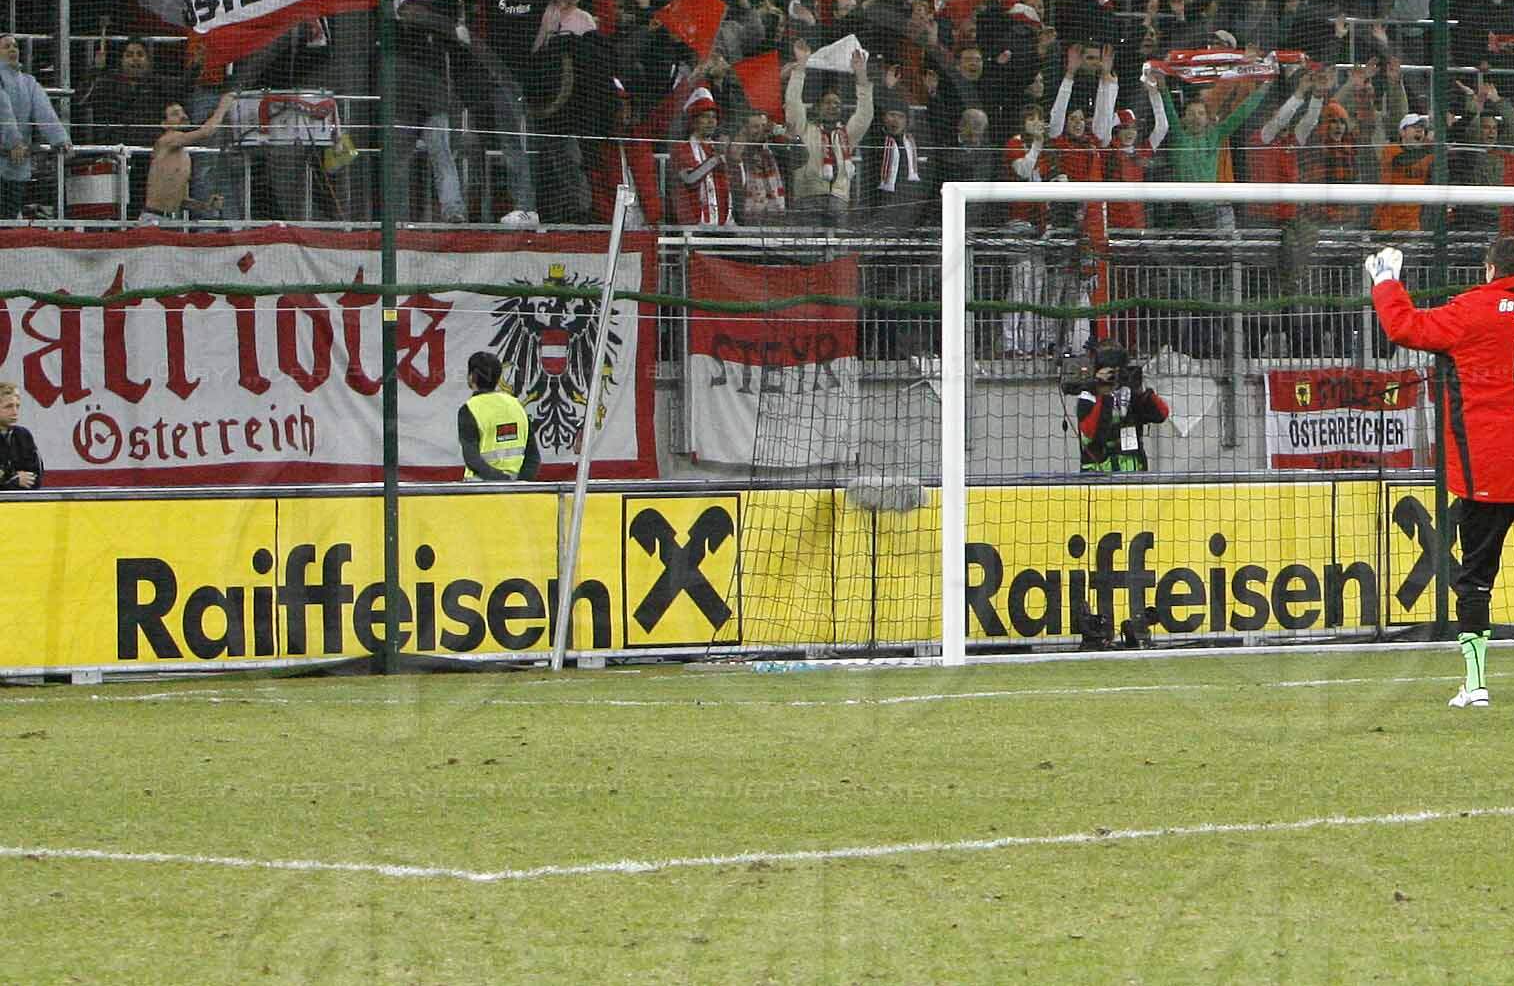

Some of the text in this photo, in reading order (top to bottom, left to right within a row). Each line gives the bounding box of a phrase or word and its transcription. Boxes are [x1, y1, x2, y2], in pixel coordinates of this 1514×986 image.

[0, 251, 453, 409] atriots
[710, 332, 841, 395] STEYR
[72, 405, 315, 464] Österreich
[1288, 412, 1404, 448] ÖSTERREICHER
[116, 543, 612, 660] Raiffeisen
